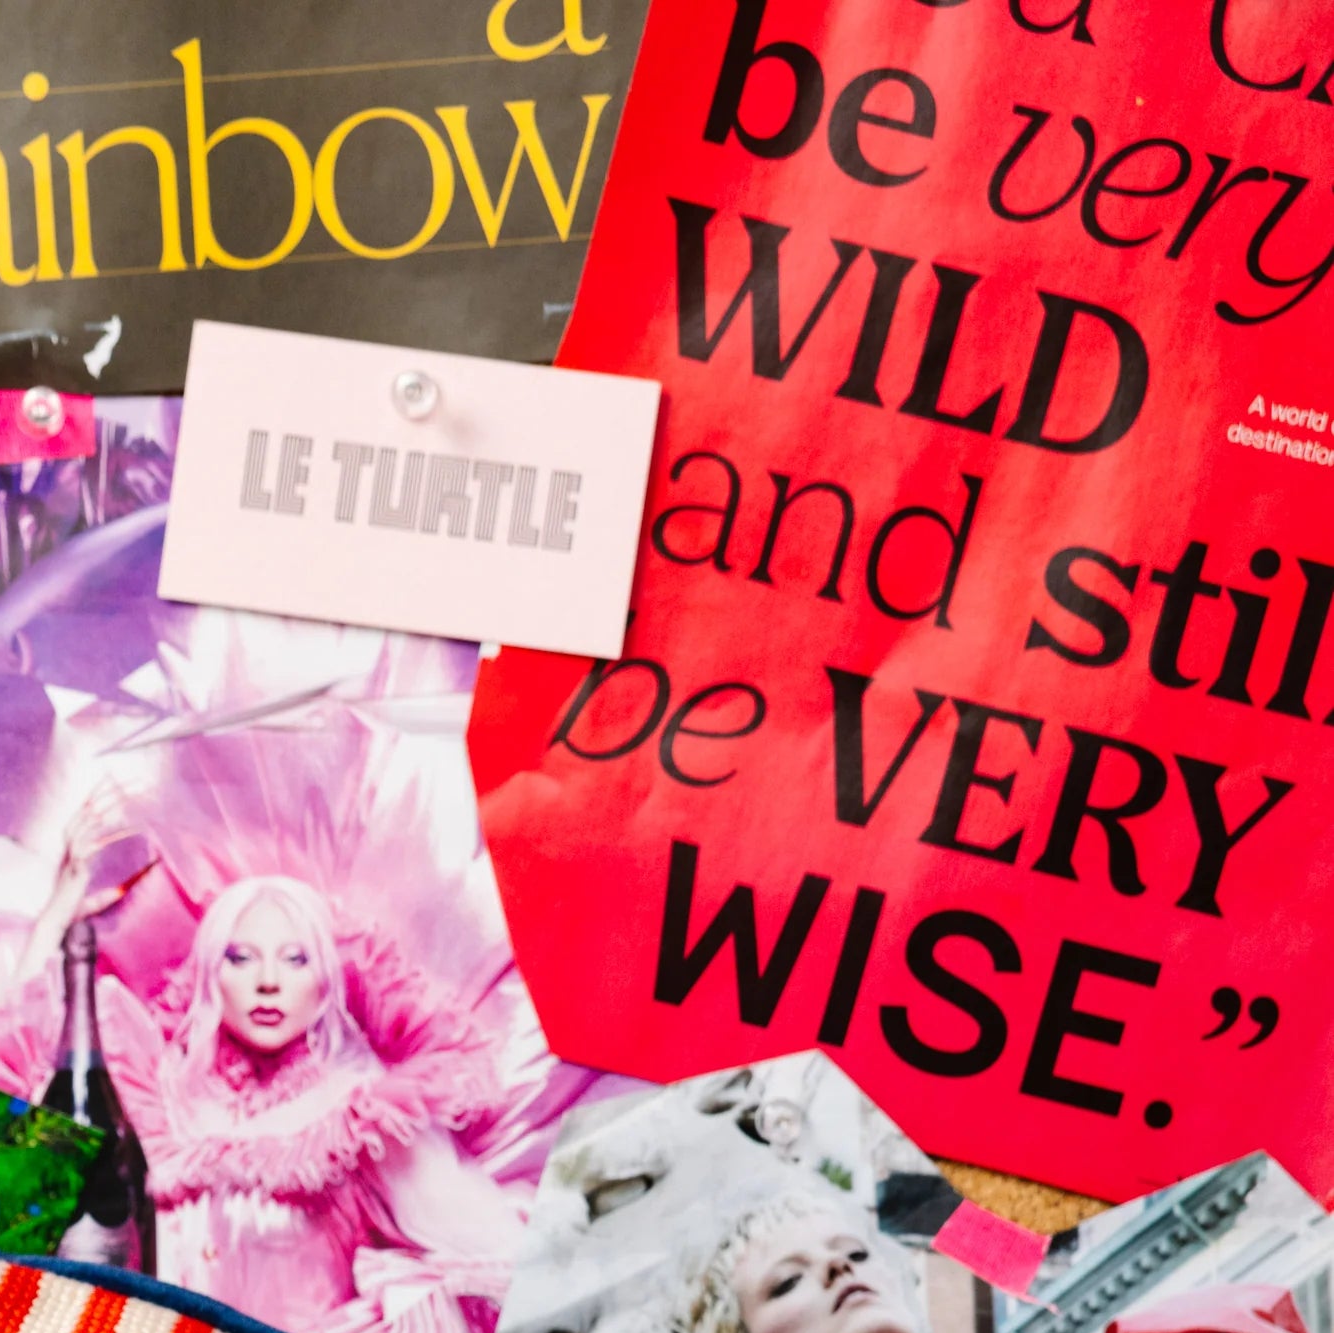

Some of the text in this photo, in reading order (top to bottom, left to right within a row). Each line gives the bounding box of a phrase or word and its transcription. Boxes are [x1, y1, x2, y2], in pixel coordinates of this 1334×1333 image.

[703, 0, 1334, 326] be very
[667, 196, 1150, 456] WILD
[1247, 394, 1329, 433] A world
[240, 429, 582, 553] LE TURTLE
[651, 450, 1334, 727] and stil
[549, 610, 1296, 918] be VERY
